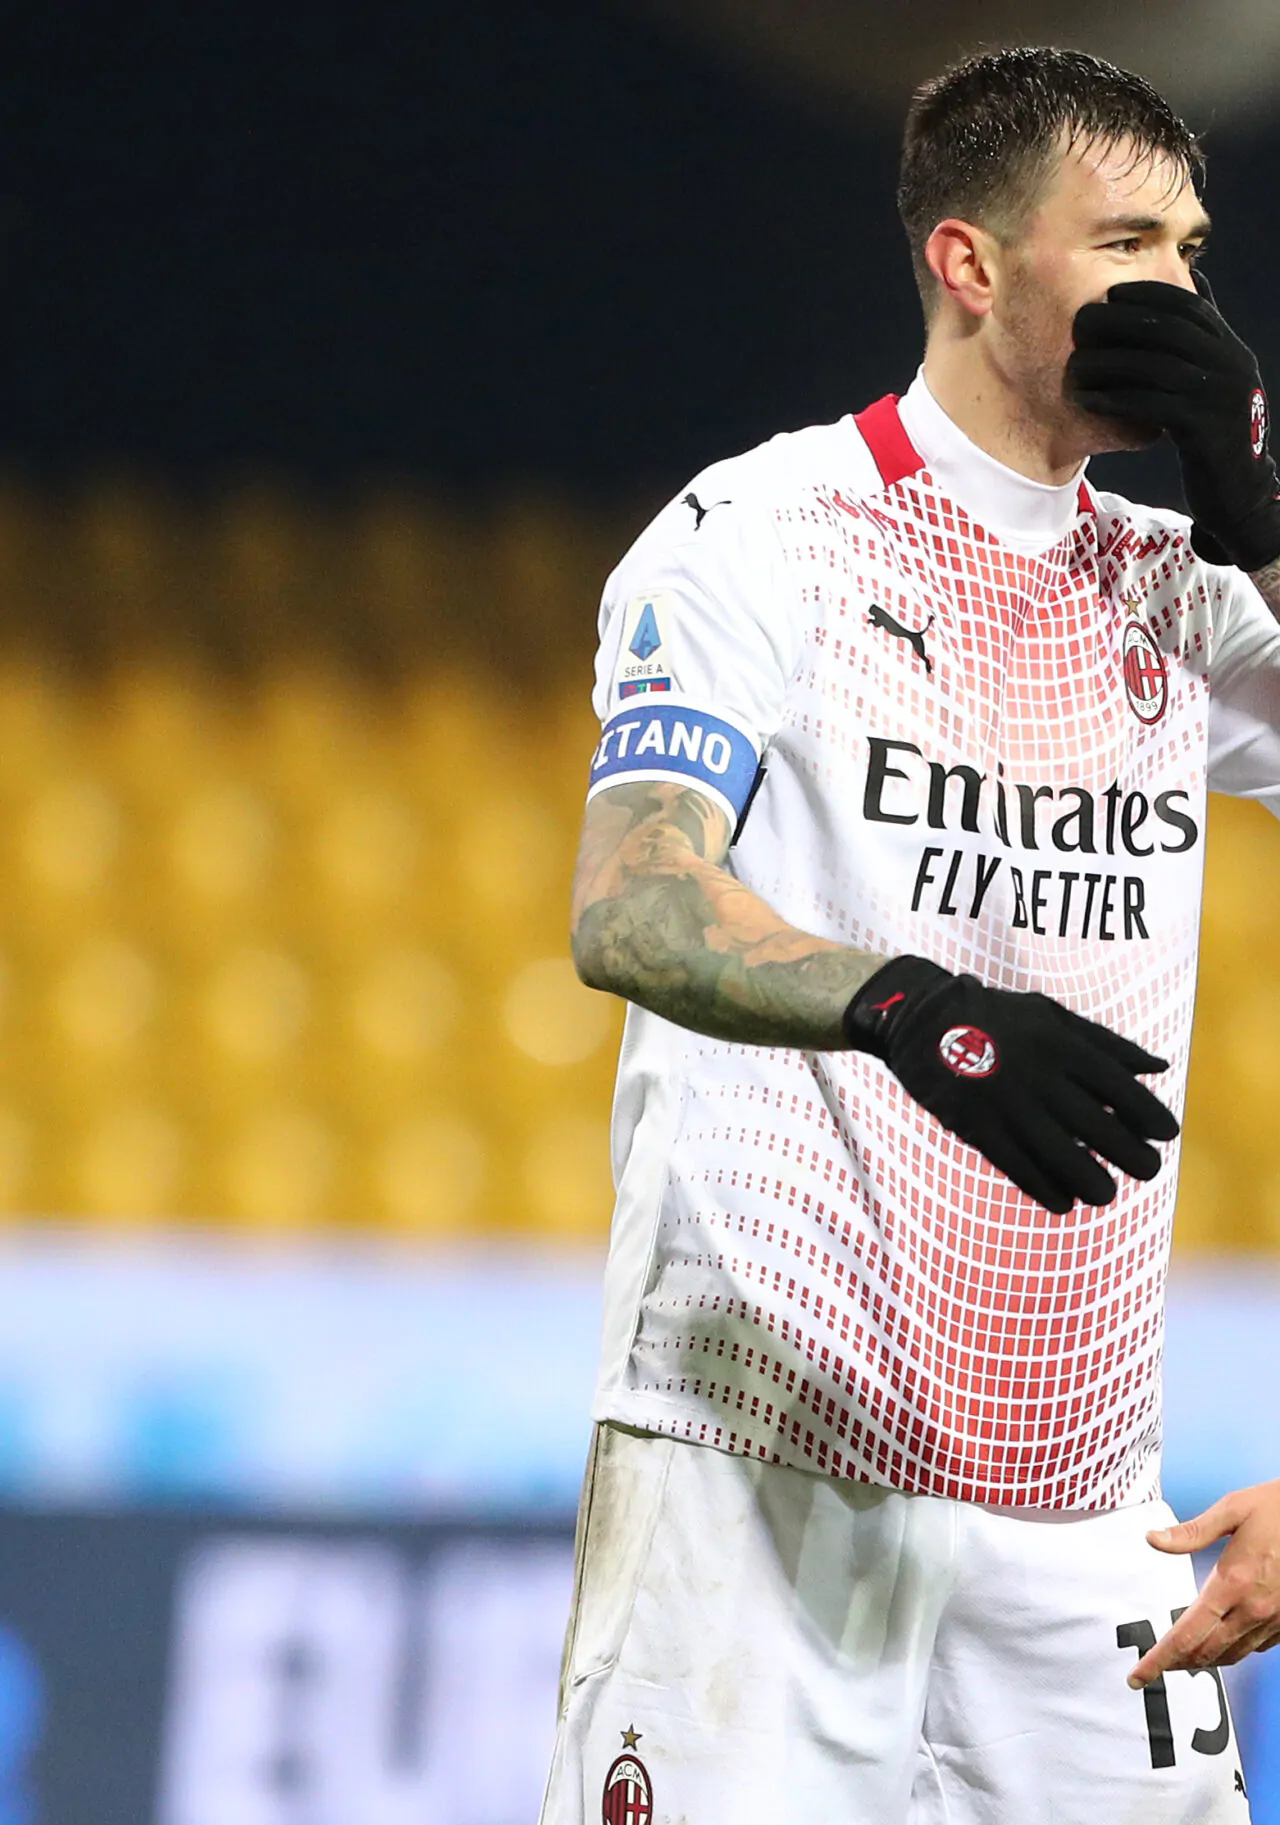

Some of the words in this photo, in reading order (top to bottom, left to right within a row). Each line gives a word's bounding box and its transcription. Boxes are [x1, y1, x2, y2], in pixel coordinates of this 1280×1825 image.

[624, 664, 652, 678] SERIE
[656, 664, 664, 674] A
[1135, 701, 1158, 712] 1899
[591, 719, 732, 775] ITANO
[863, 736, 1198, 857] Emirates
[910, 846, 1002, 920] FLY
[1010, 865, 1150, 941] BETTER
[615, 1763, 642, 1783] ACM
